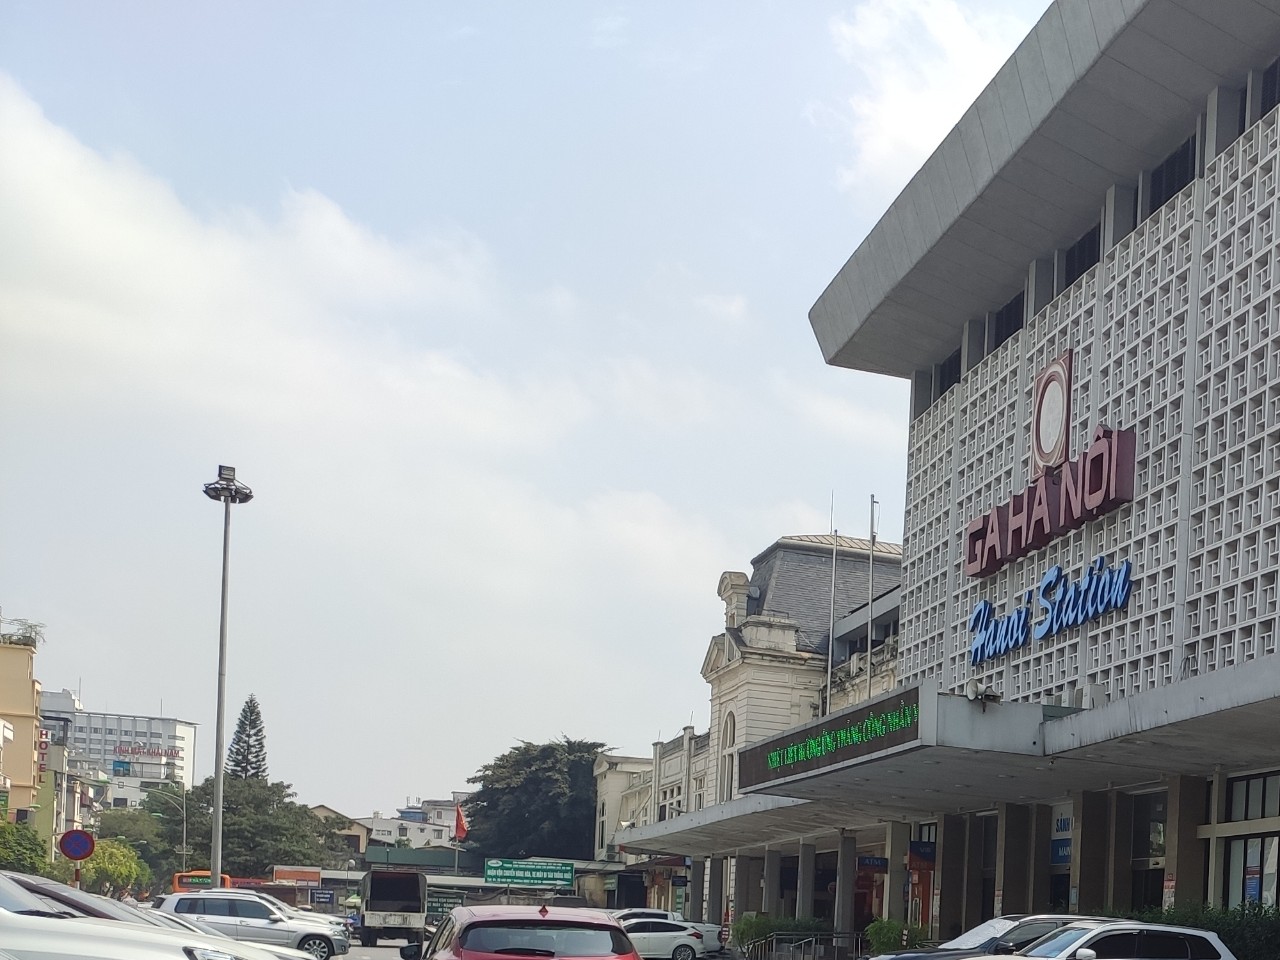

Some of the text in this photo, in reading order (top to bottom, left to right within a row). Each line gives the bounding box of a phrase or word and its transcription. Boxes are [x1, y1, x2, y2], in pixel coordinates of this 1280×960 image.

[965, 507, 1004, 578] GA
[1059, 424, 1126, 530] NỘI
[970, 556, 1133, 666] Hanoi Station
[862, 711, 886, 743] CÔNG
[39, 730, 48, 783] HOTEL
[864, 858, 881, 866] ATM
